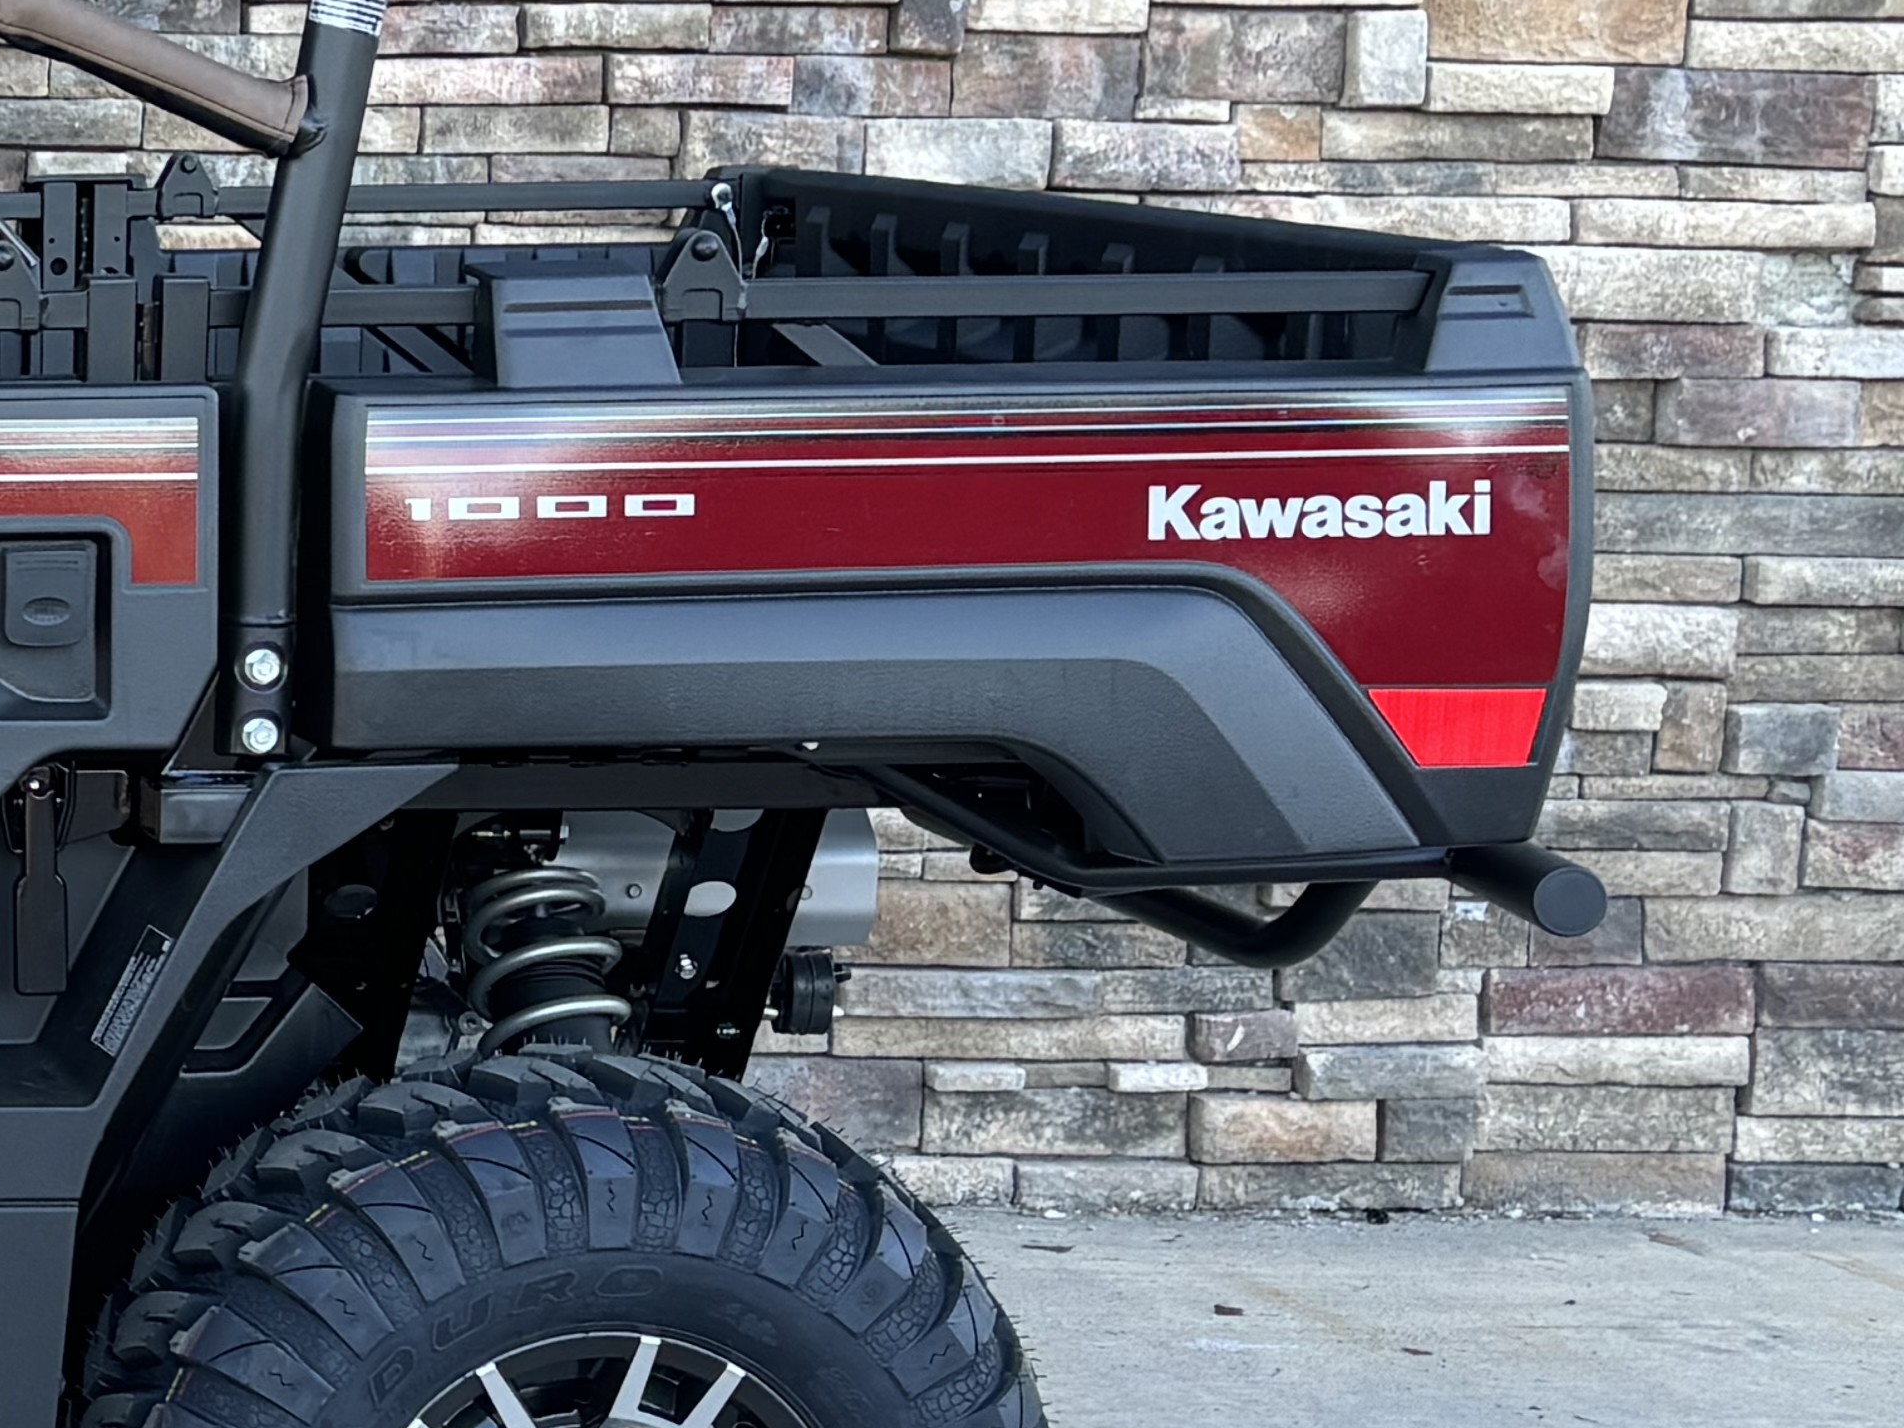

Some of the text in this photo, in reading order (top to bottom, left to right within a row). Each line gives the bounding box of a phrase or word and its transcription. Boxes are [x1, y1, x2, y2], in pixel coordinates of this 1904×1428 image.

[404, 494, 695, 521] 1000
[1147, 479, 1491, 541] Kawasaki
[368, 1264, 664, 1409] DURO
